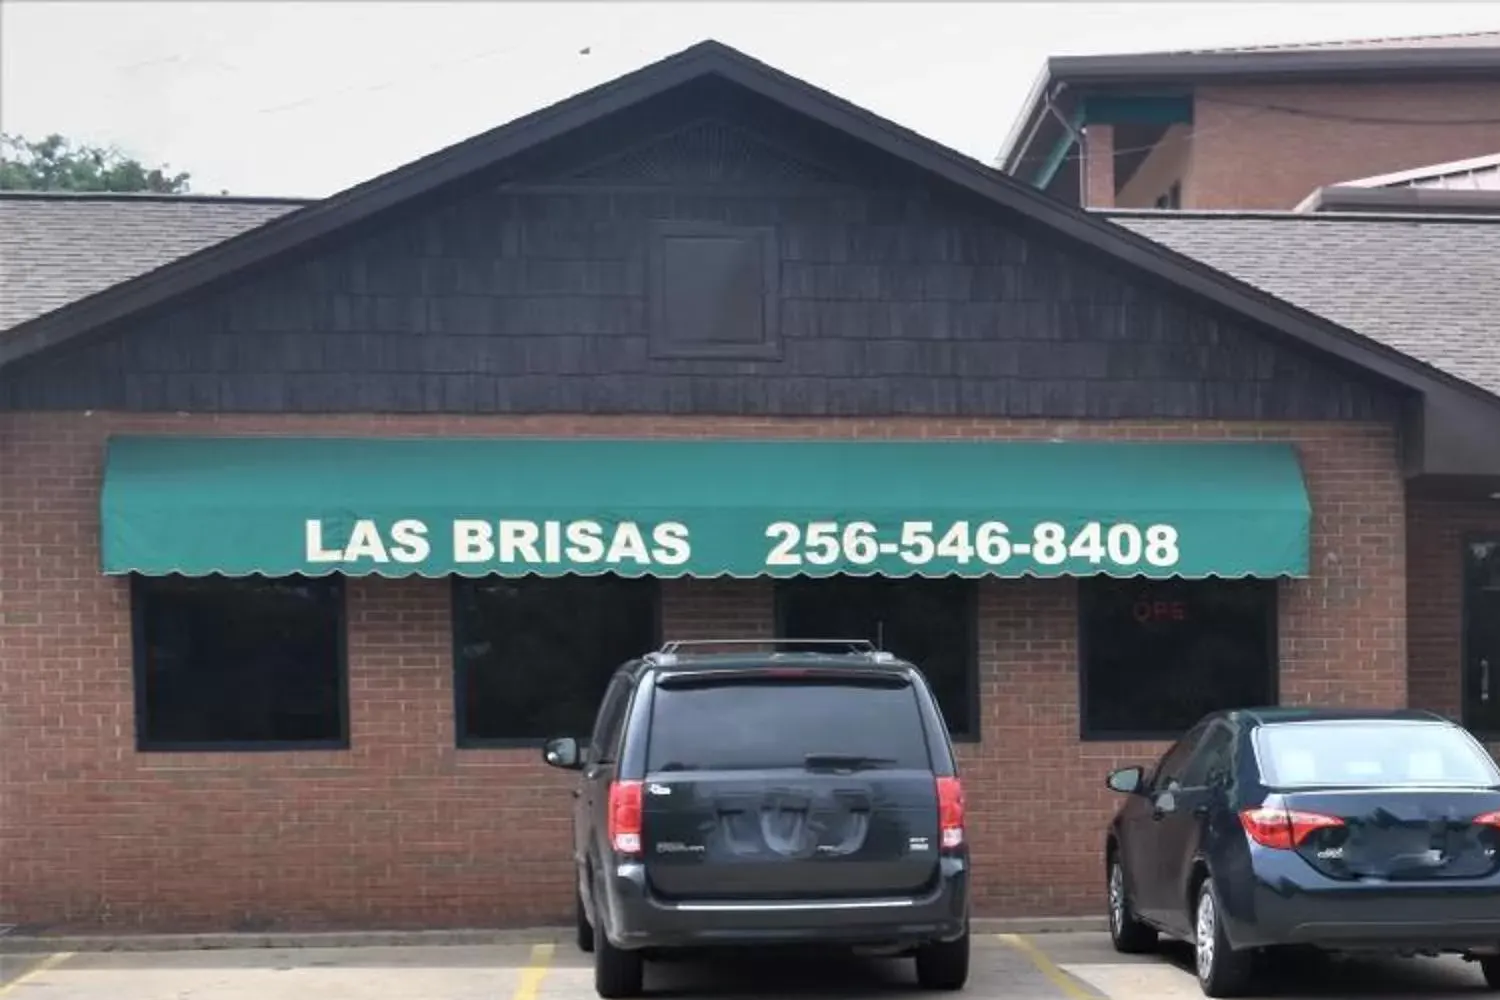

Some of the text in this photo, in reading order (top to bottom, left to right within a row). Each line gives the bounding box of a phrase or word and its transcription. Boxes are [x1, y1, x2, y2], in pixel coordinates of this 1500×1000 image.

[306, 519, 1179, 567] LAS BRISAS 256-546-8408
